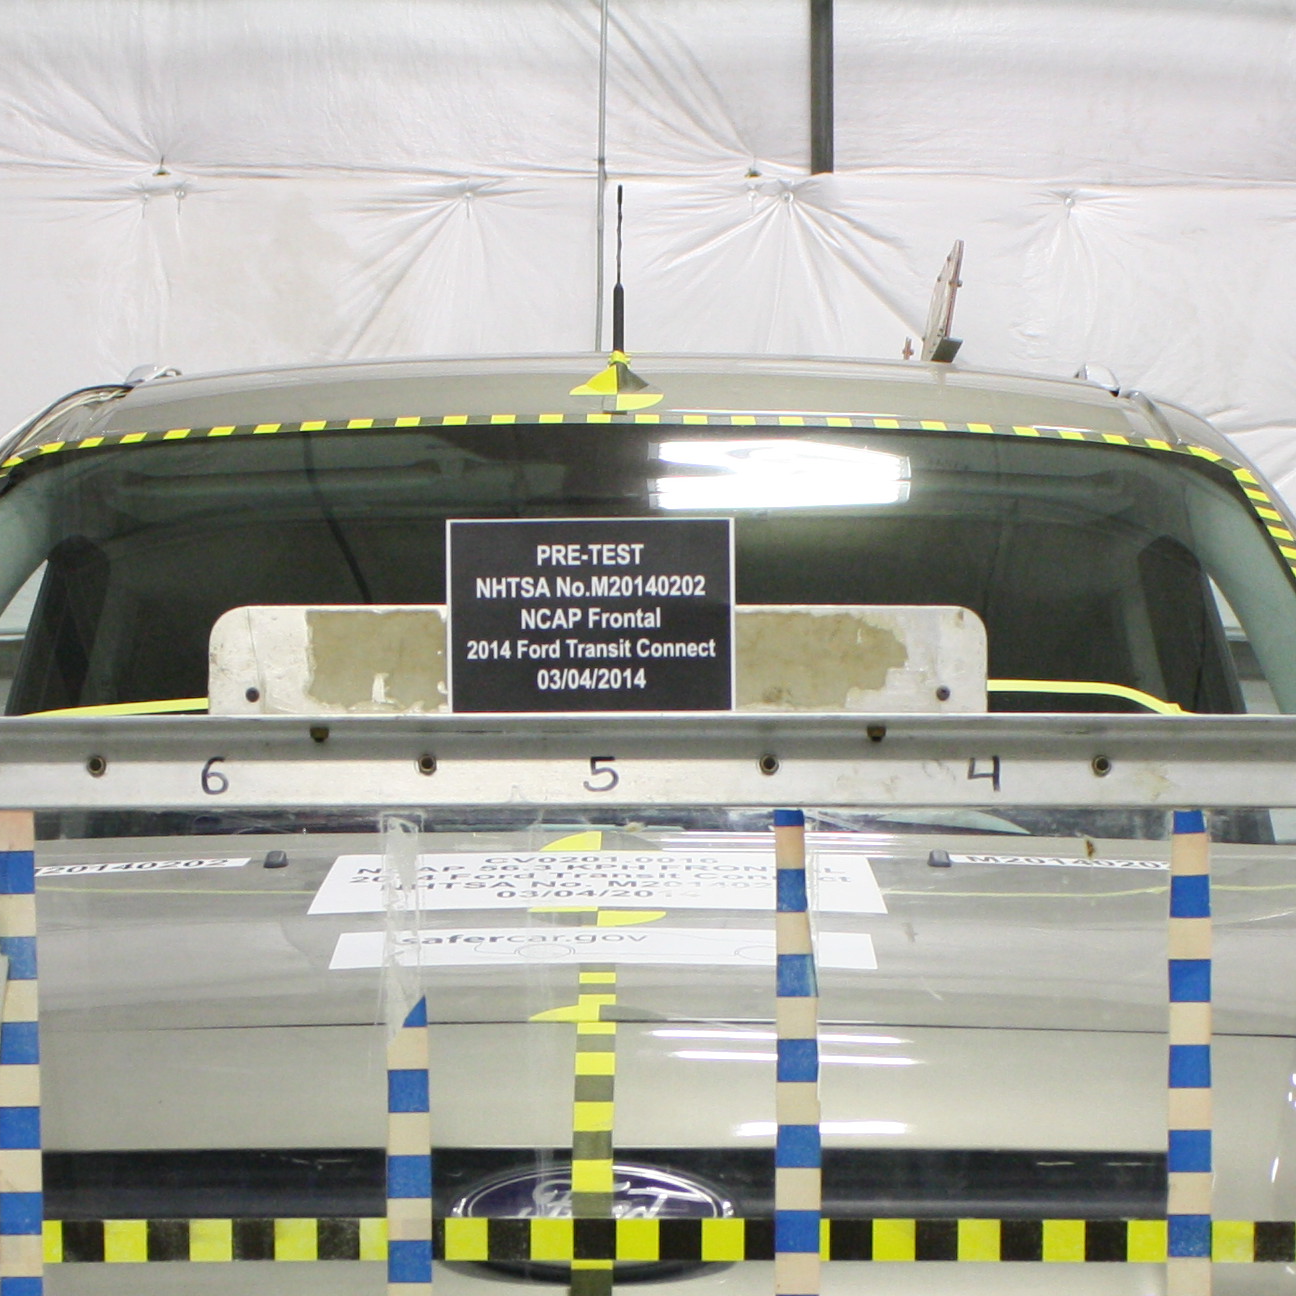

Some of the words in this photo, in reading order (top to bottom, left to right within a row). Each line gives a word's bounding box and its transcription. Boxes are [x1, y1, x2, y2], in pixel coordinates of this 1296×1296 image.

[537, 544, 644, 565] PRE-TEST
[476, 577, 550, 598] NHTSA
[556, 575, 706, 597] No.M20140202
[521, 609, 581, 630] NCAP
[588, 607, 661, 628] Frontal
[467, 641, 511, 660] 2014
[517, 640, 561, 659] Ford
[566, 639, 631, 658] Transit
[636, 638, 716, 657] Connect
[537, 668, 646, 690] 03/04/2014
[201, 756, 229, 796] 6
[584, 756, 620, 793] 5
[967, 755, 1001, 792] 4
[34, 859, 229, 875] 20140202
